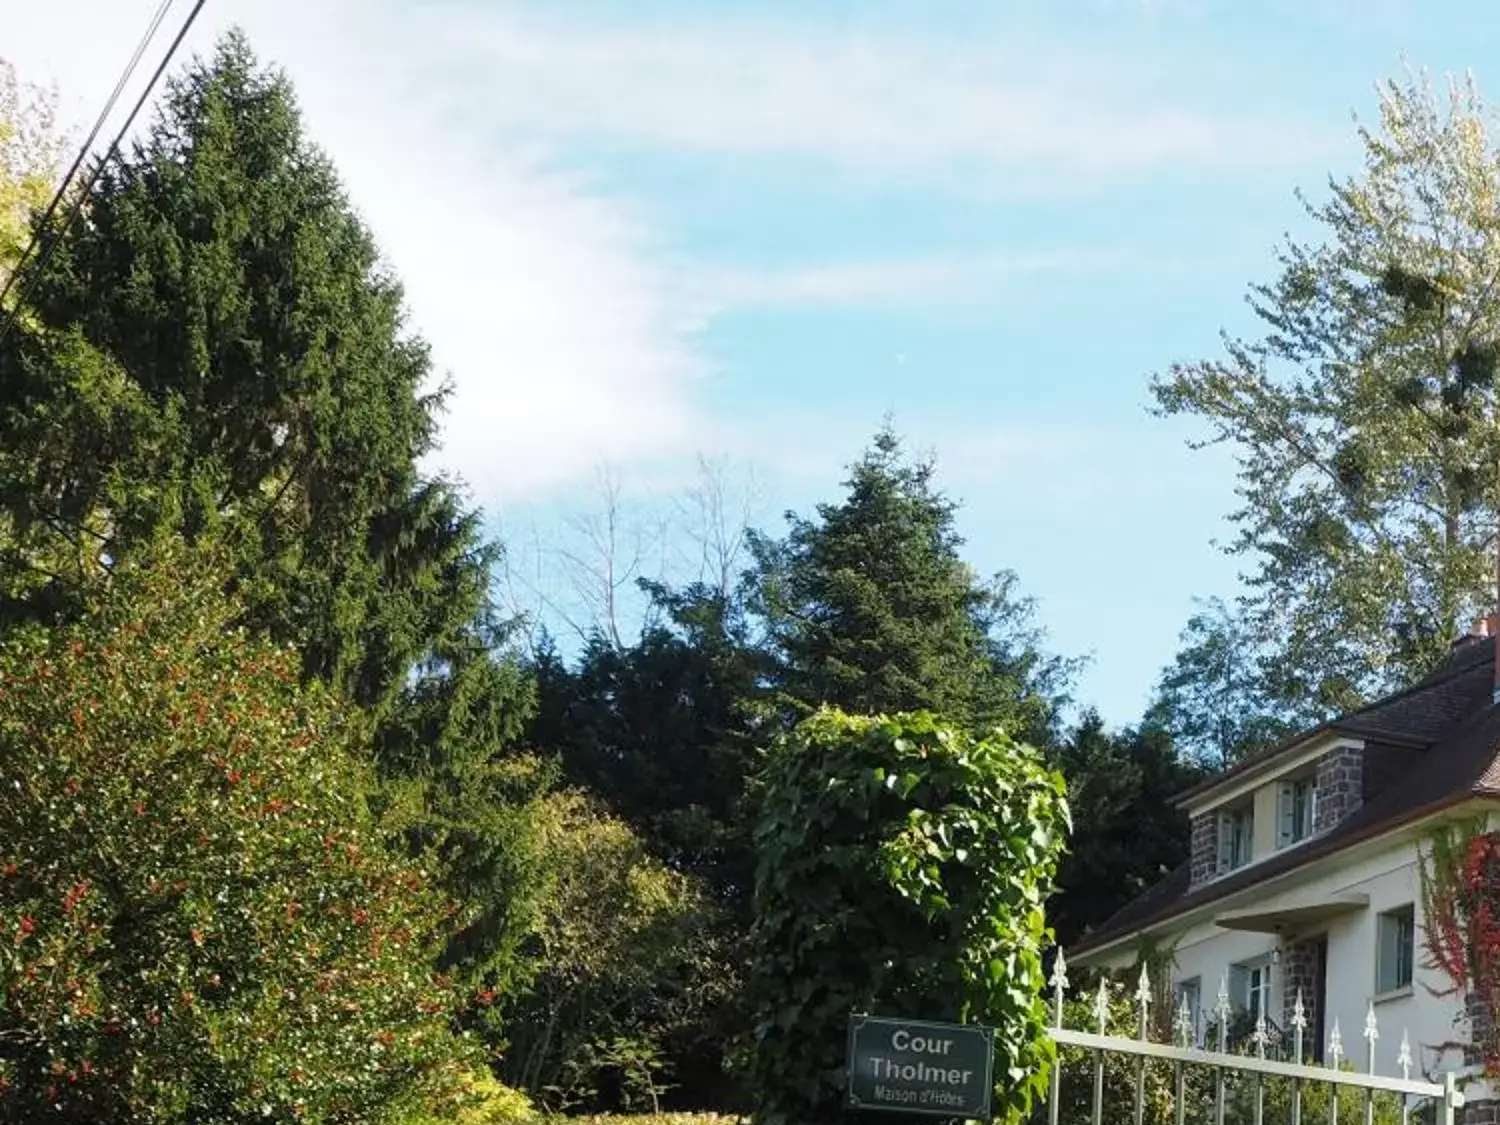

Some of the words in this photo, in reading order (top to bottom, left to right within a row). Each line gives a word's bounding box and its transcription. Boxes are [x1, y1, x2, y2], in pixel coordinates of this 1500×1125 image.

[892, 1030, 953, 1055] Cour
[869, 1057, 973, 1085] Tholmer
[874, 1084, 917, 1103] Maison
